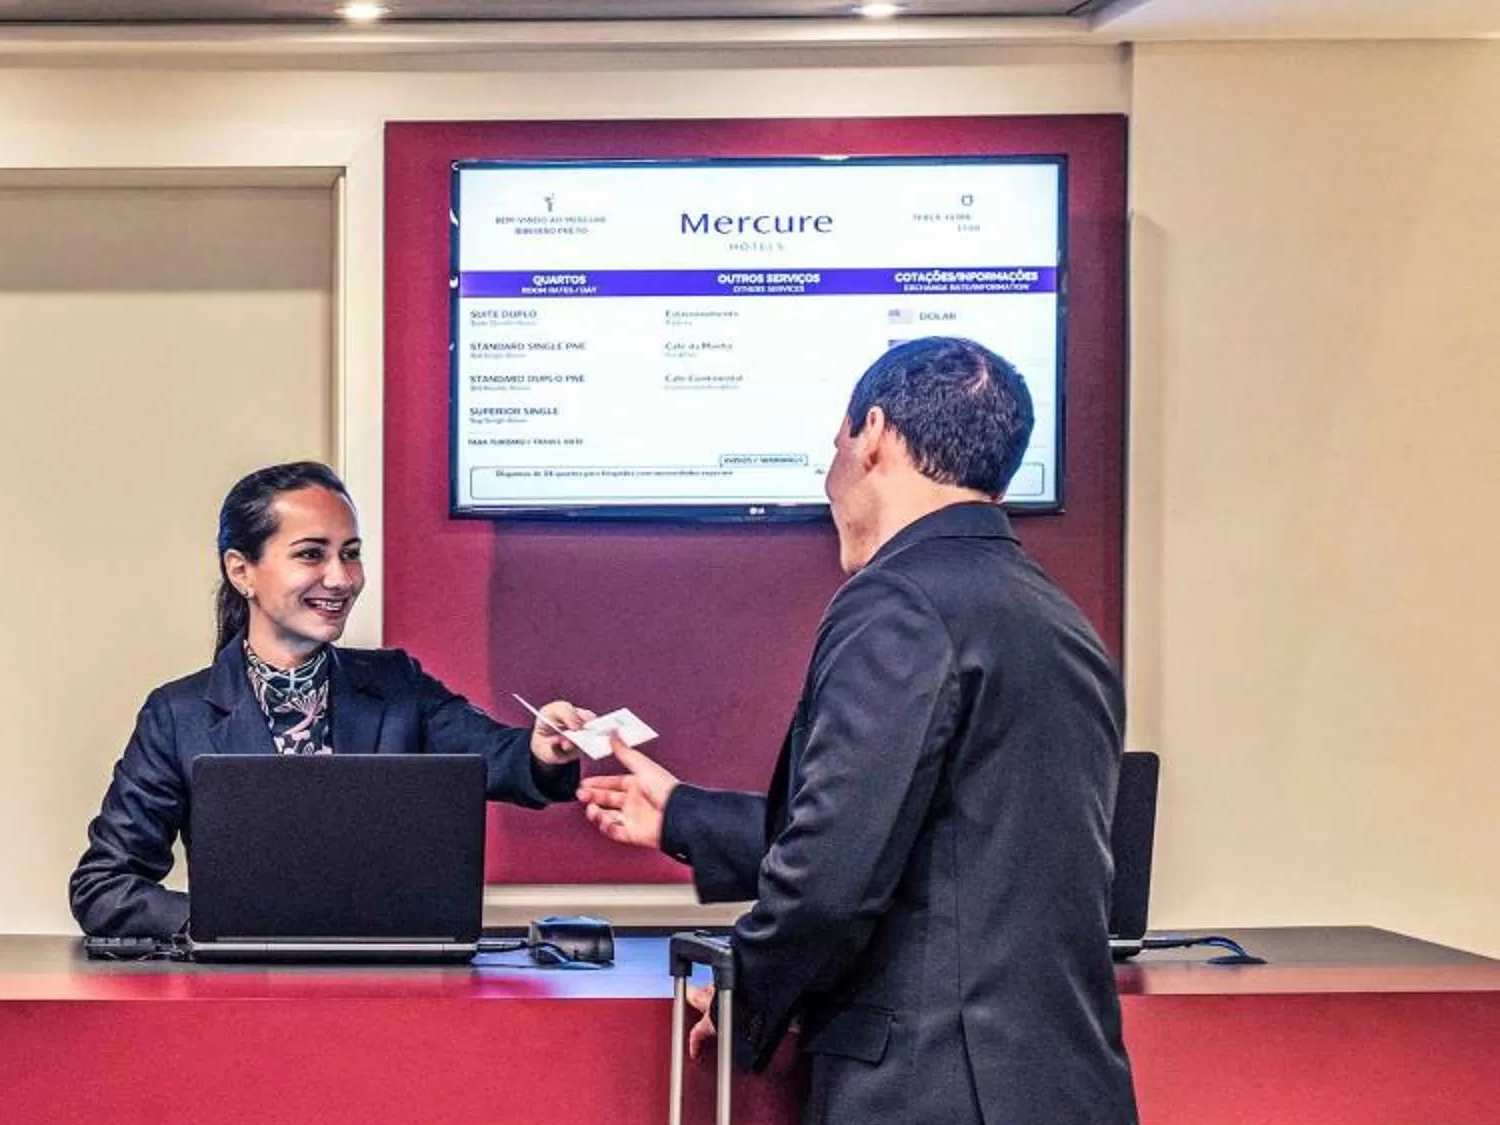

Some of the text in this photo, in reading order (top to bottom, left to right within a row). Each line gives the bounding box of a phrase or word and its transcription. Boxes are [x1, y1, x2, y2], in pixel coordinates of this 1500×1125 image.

[680, 212, 833, 235] Mercure
[532, 274, 587, 286] QUARTOS
[717, 273, 821, 285] OUTROS SERVIÇOS
[895, 269, 1039, 284] COTAÇÕES/INFORMAÇÕES
[470, 342, 525, 351] STANDARD
[470, 375, 525, 383] STANDARD
[470, 407, 521, 415] SUPERIOR
